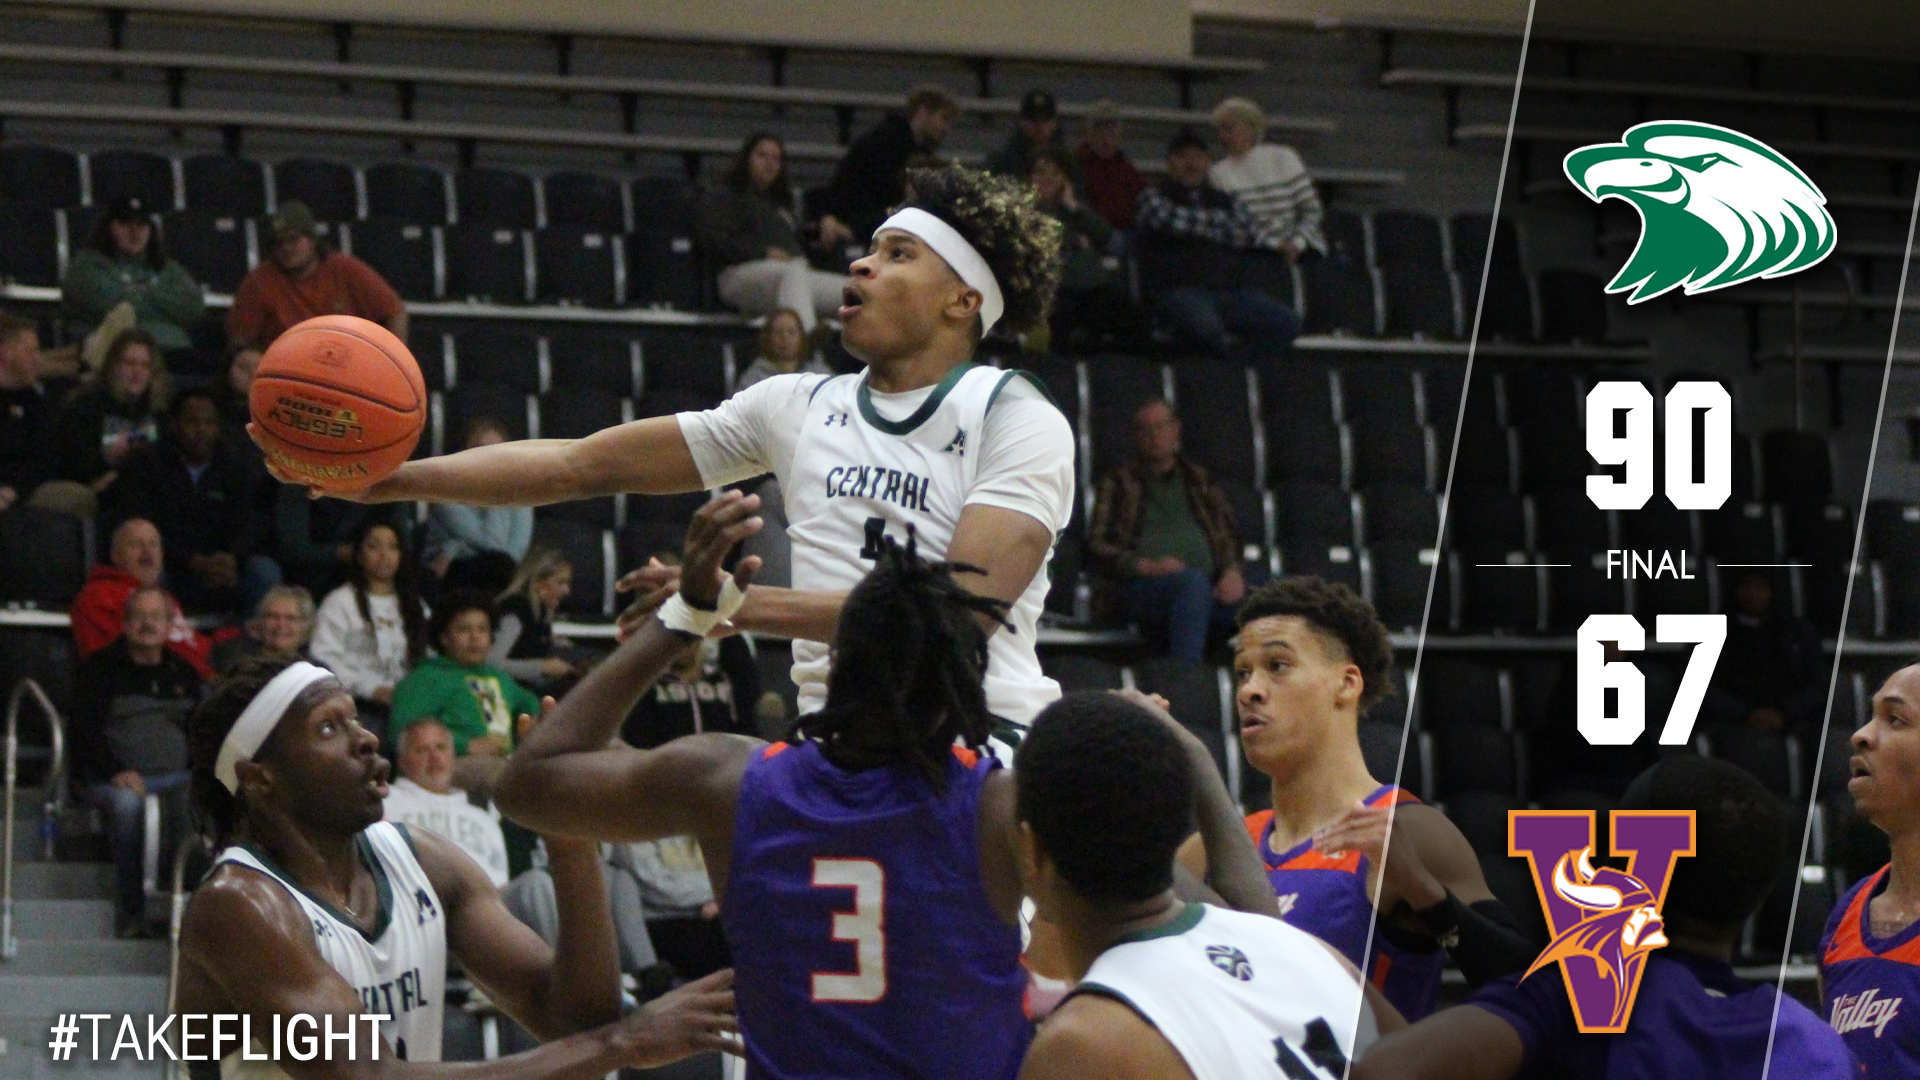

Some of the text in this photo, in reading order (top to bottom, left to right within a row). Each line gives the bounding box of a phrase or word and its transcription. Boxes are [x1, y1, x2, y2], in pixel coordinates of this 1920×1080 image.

[269, 409, 364, 443] LEGACY
[826, 465, 931, 513] CENTRAL
[811, 857, 886, 1003] 3
[1830, 988, 1903, 1039] Valley
